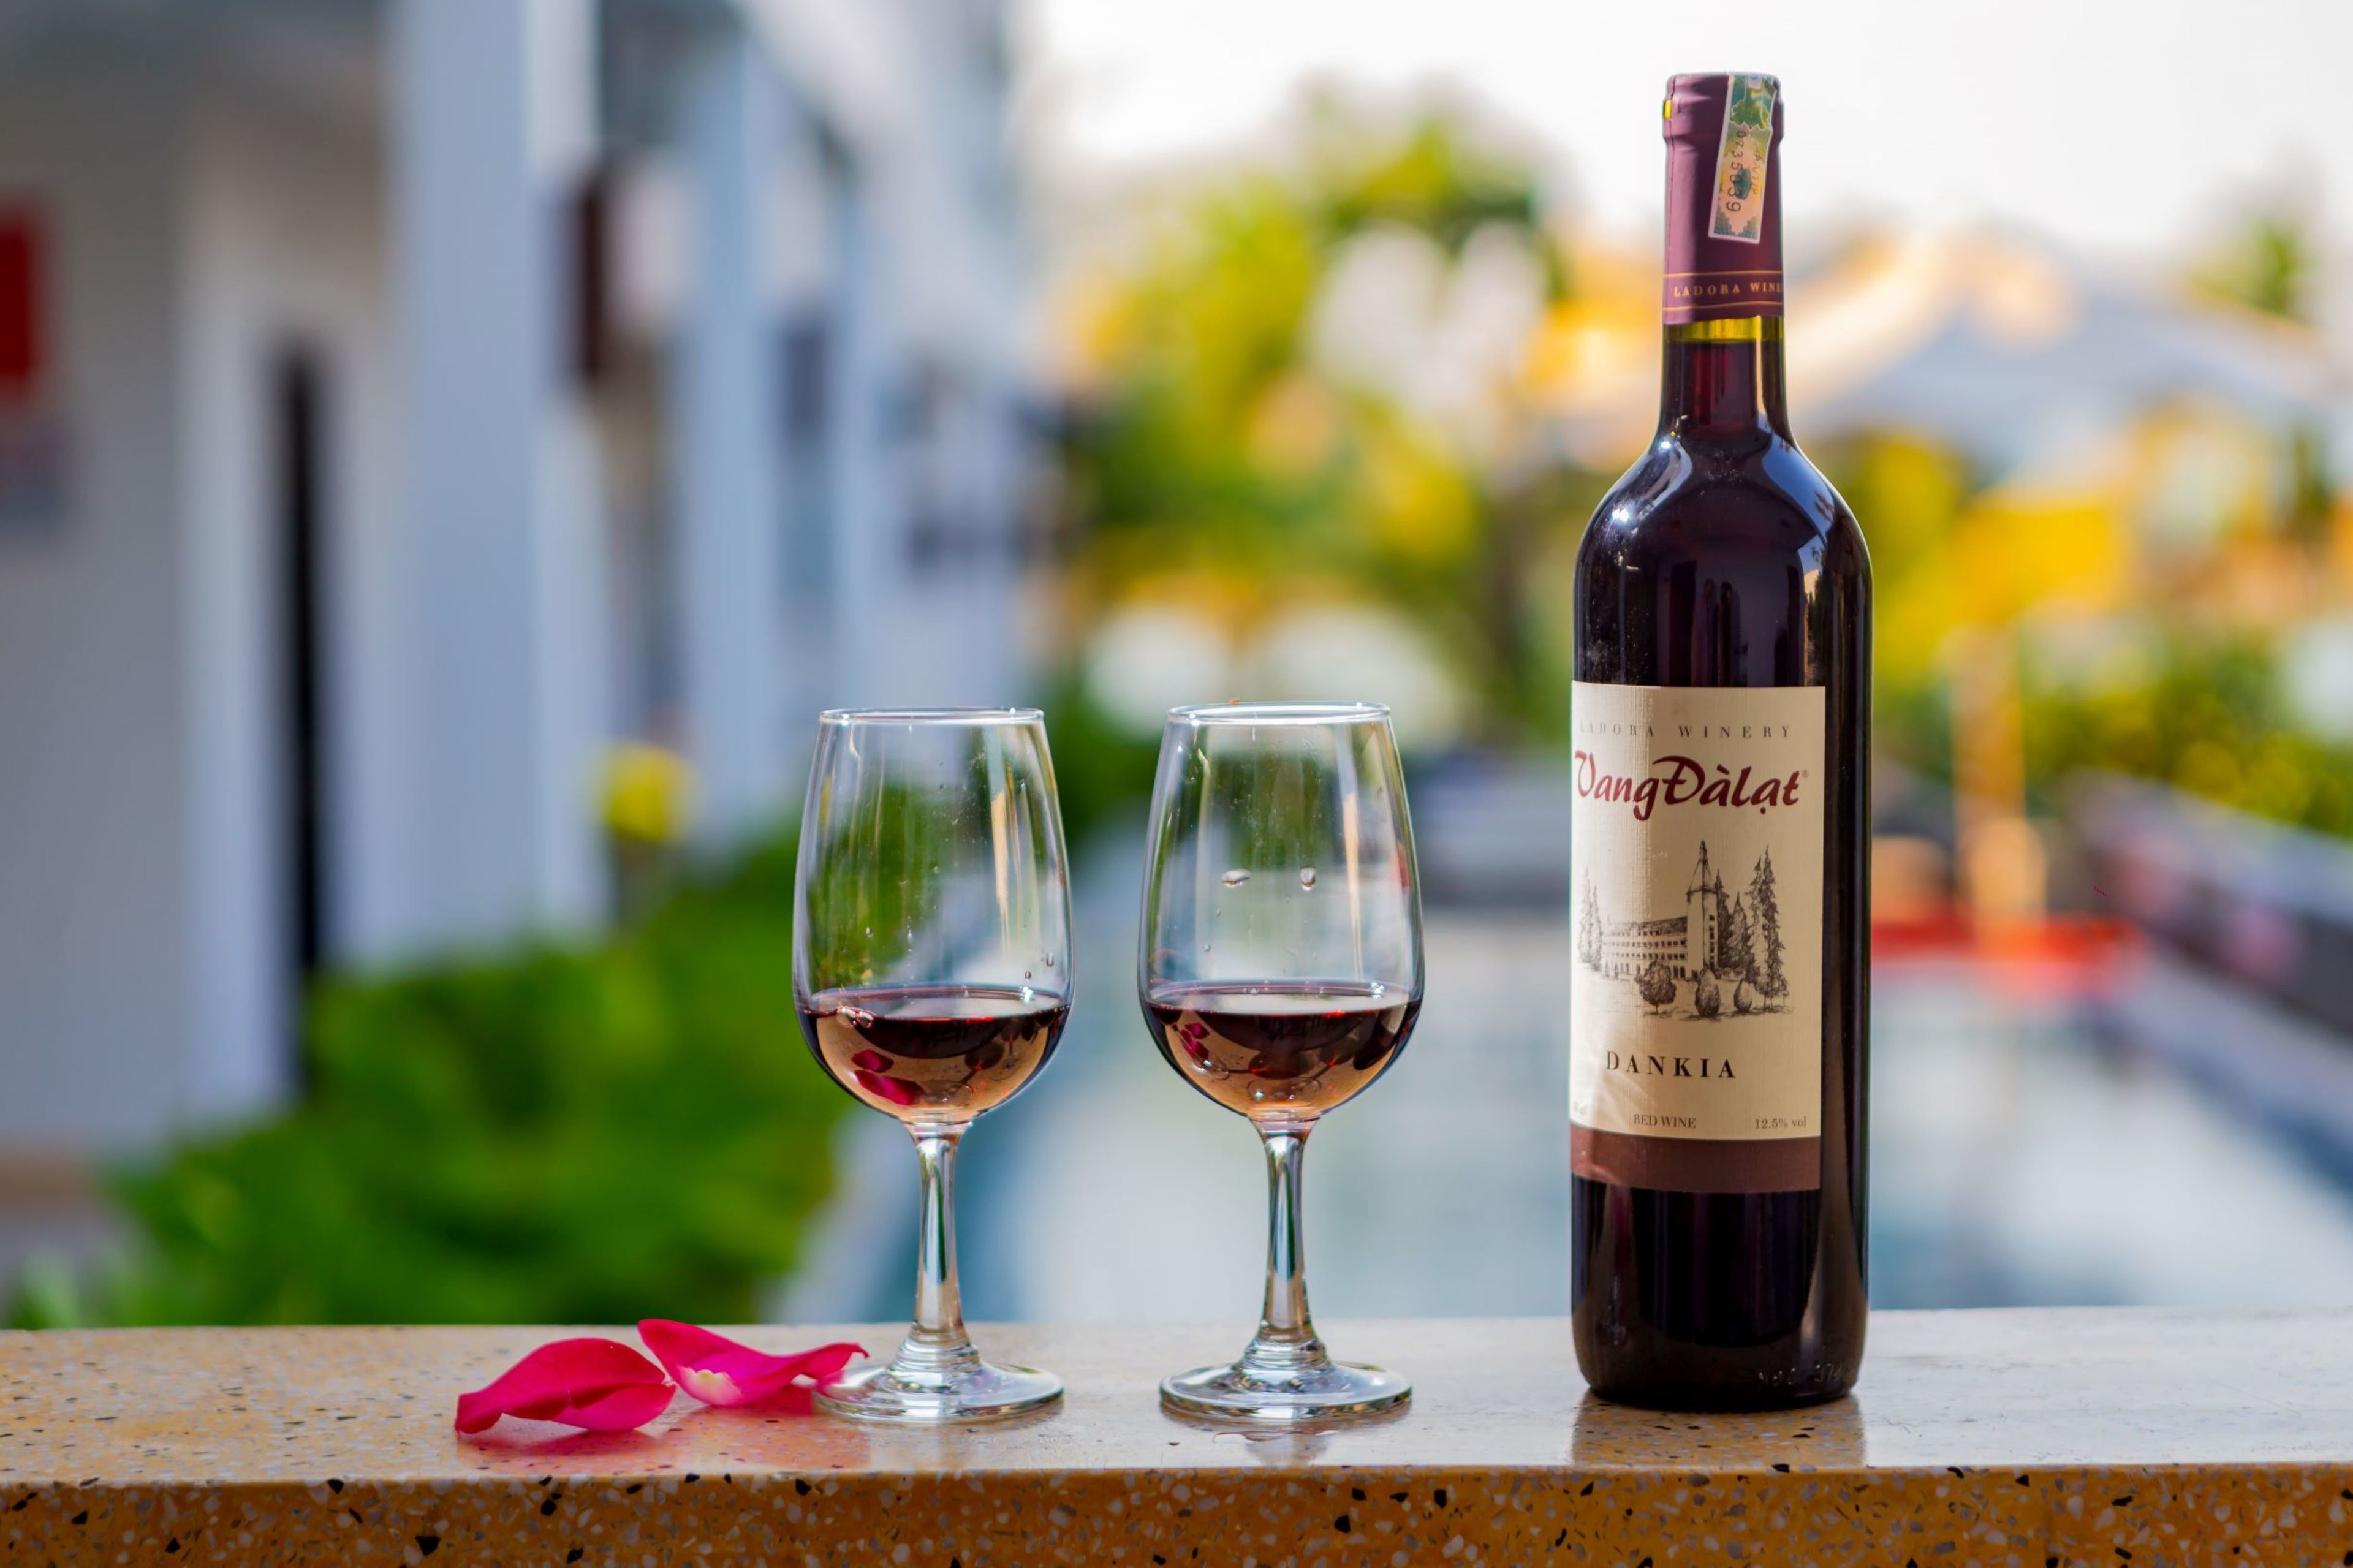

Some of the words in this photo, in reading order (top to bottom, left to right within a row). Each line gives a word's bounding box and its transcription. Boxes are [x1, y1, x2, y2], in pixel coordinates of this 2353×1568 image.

[1673, 283, 1740, 297] LADORA
[1580, 721, 1654, 737] LADORA
[1679, 725, 1790, 738] WINERY
[1606, 1050, 1735, 1078] DANKIA
[1634, 1113, 1658, 1126] RED
[1661, 1116, 1696, 1129] WINE
[1754, 1118, 1788, 1129] 12.5%
[1791, 1116, 1807, 1128] vol
